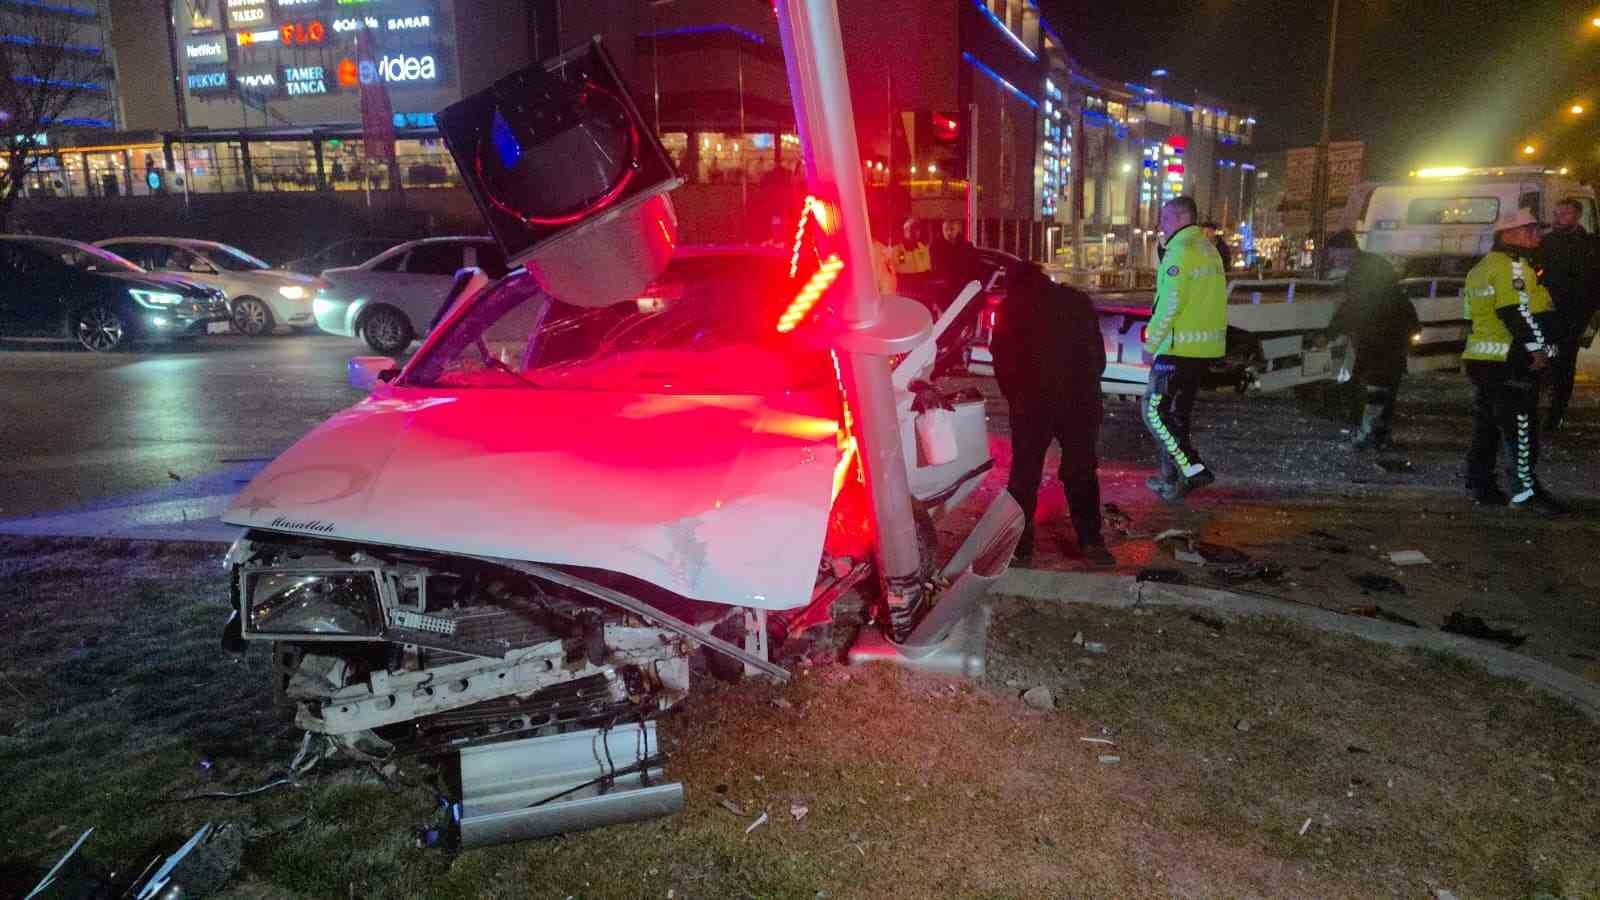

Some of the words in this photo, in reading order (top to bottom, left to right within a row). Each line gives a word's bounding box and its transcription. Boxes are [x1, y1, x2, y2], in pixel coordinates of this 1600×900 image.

[387, 15, 430, 29] SARAR
[281, 20, 324, 45] FLO
[284, 66, 324, 82] TAMER
[285, 80, 327, 96] TANCA
